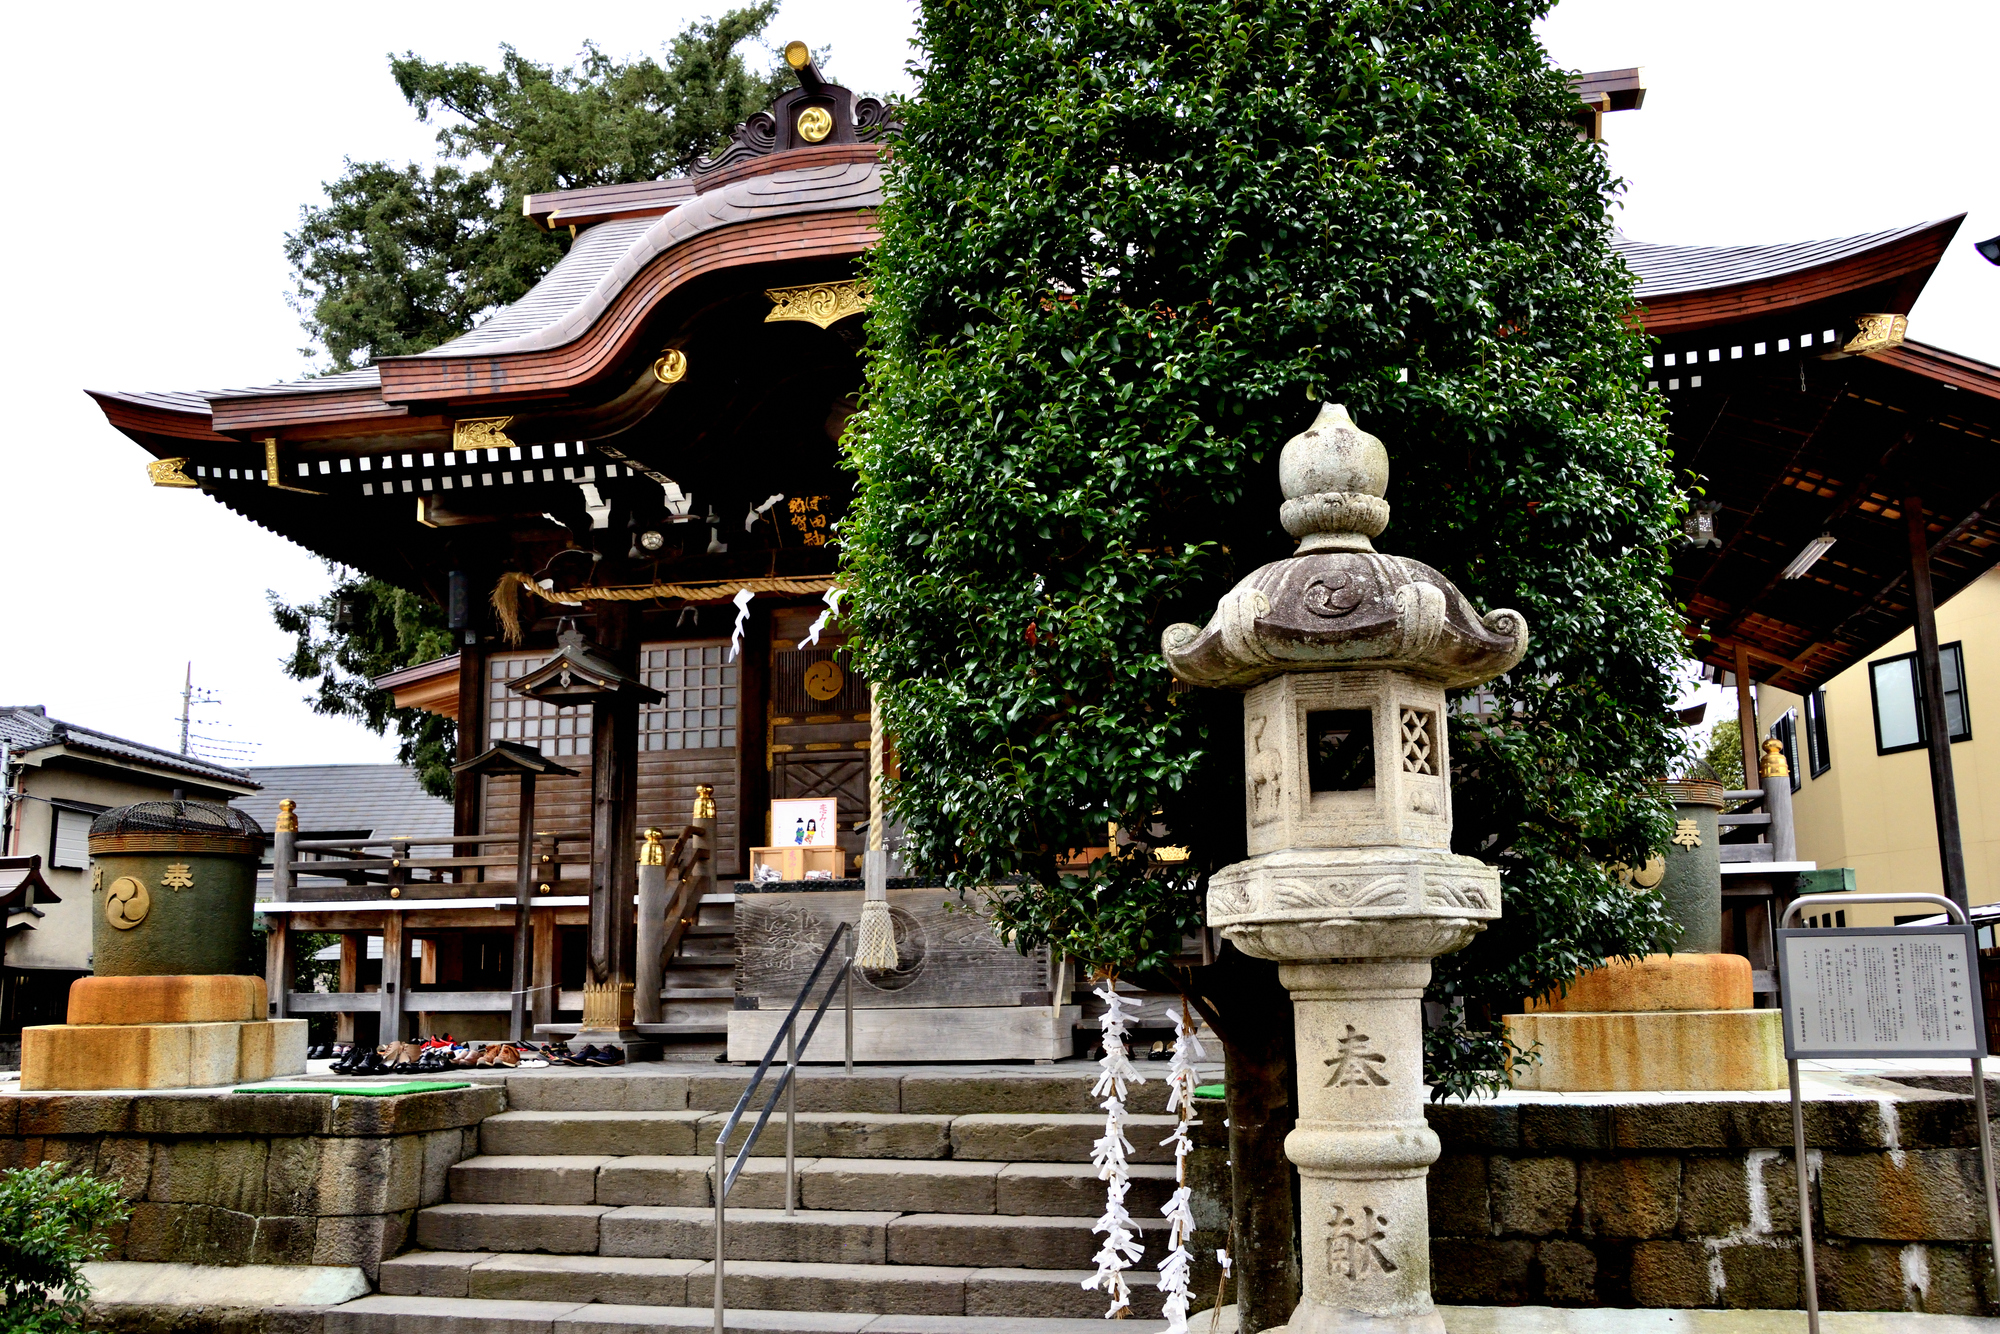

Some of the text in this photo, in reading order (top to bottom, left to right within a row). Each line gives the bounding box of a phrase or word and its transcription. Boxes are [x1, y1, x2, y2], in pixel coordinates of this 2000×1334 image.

[819, 804, 827, 838] 恋みくじ
[1671, 817, 1703, 852] 奉
[161, 862, 194, 892] 奉
[1947, 952, 1962, 1030] 健田須賀神社
[1322, 1024, 1391, 1088] 奉
[1325, 1204, 1399, 1281] 献
